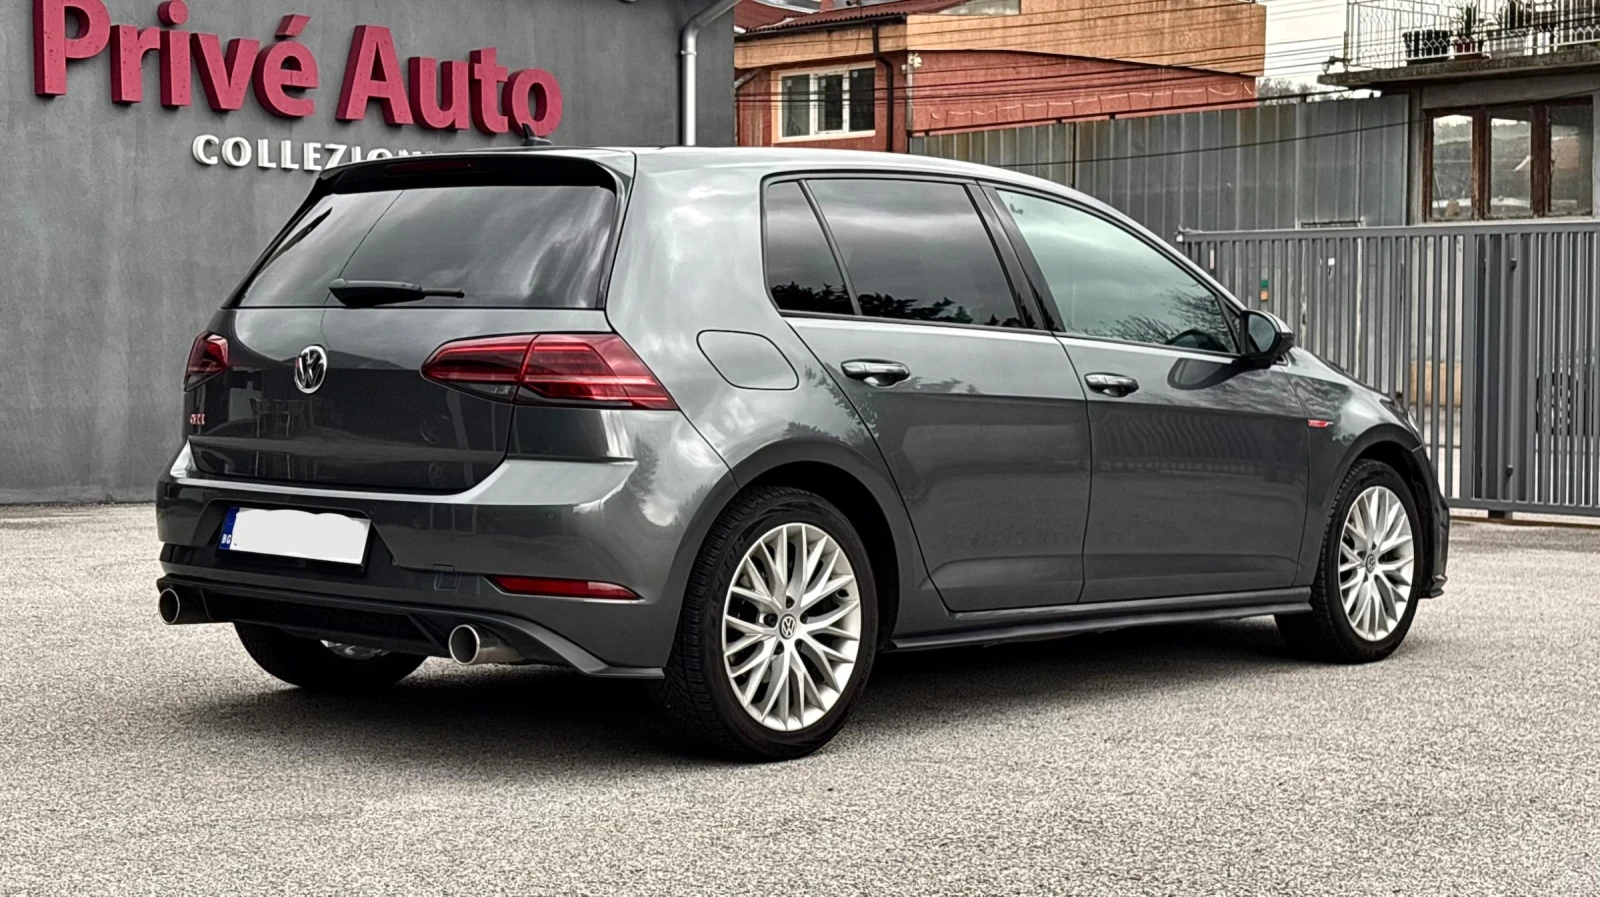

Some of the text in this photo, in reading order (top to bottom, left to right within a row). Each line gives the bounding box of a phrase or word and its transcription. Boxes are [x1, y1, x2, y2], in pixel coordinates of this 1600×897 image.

[33, 0, 563, 136] Privé Auto
[221, 534, 231, 544] BG
